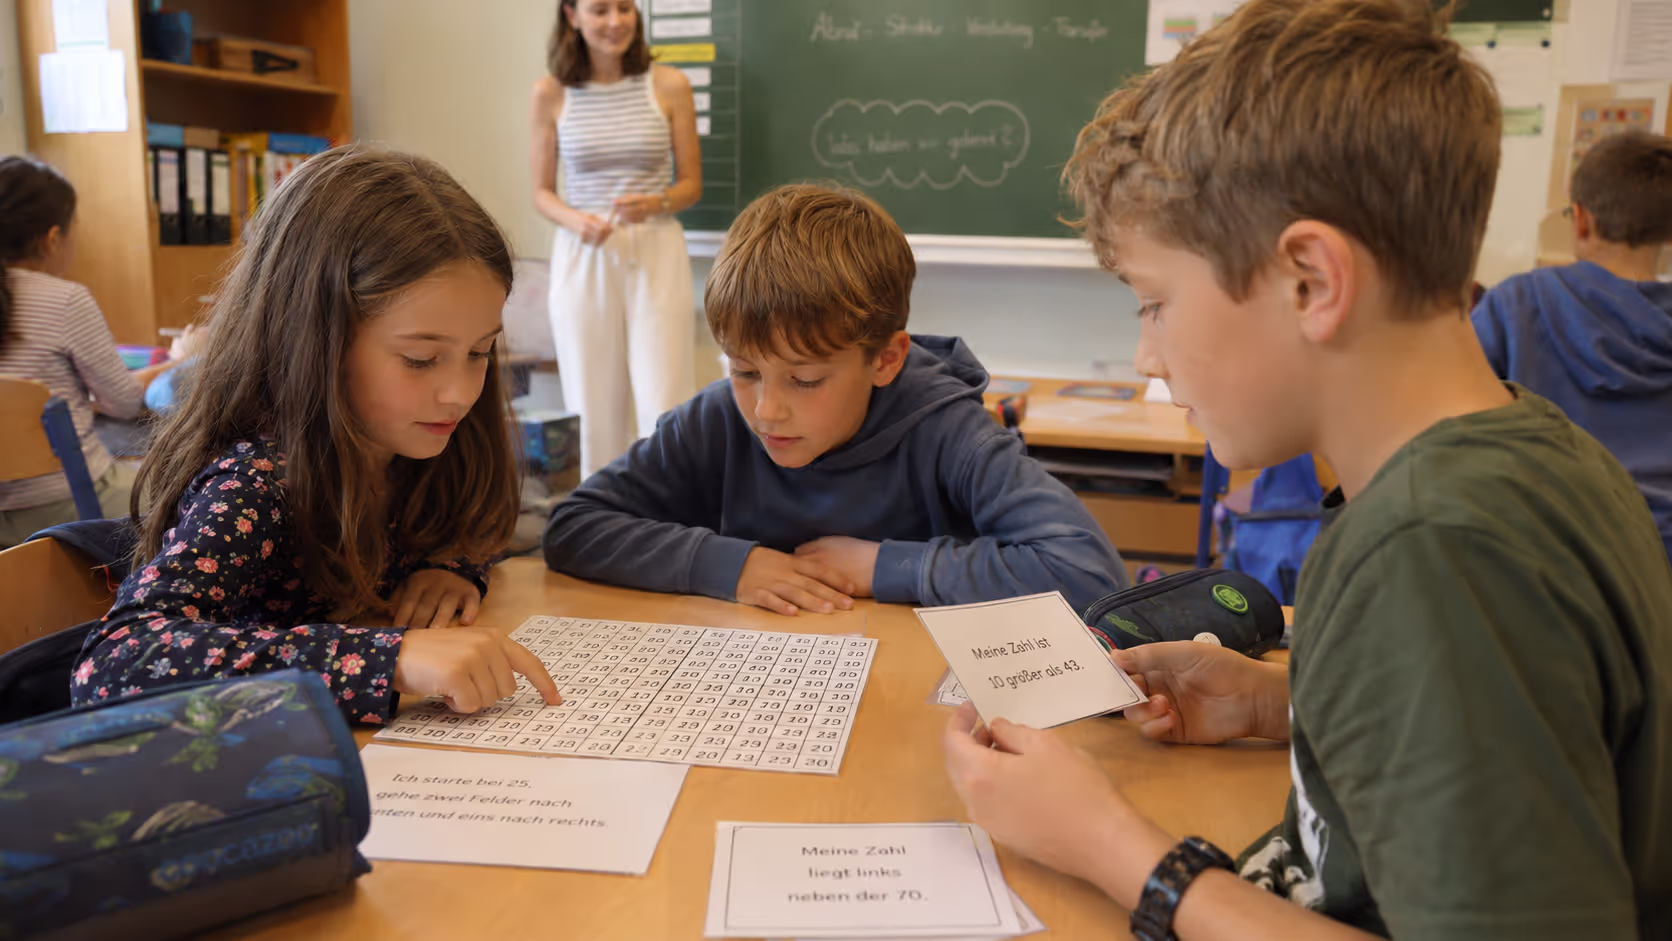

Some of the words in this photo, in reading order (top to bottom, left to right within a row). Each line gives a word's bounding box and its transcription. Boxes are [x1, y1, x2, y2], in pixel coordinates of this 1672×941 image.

[971, 645, 1009, 660] Meine
[1006, 639, 1036, 654] Zahl
[1033, 637, 1052, 649] ist
[988, 675, 1005, 689] 10
[1006, 669, 1044, 689] größer
[1045, 663, 1064, 677] als
[1063, 659, 1085, 672] 43.
[392, 773, 419, 783] Ich
[422, 776, 473, 785] starte
[476, 777, 504, 786] bei
[376, 791, 421, 801] gehe
[423, 793, 467, 802] zwei
[468, 794, 526, 805] Felder
[529, 799, 573, 808] nach
[371, 808, 415, 817] nten
[420, 811, 456, 820] und
[458, 812, 496, 822] eins
[500, 816, 544, 825] nach
[801, 846, 859, 856] Meine
[865, 845, 906, 856] Zahl
[808, 867, 850, 880] liegt
[857, 866, 902, 878] links
[787, 890, 850, 901] neben
[856, 890, 889, 901] der
